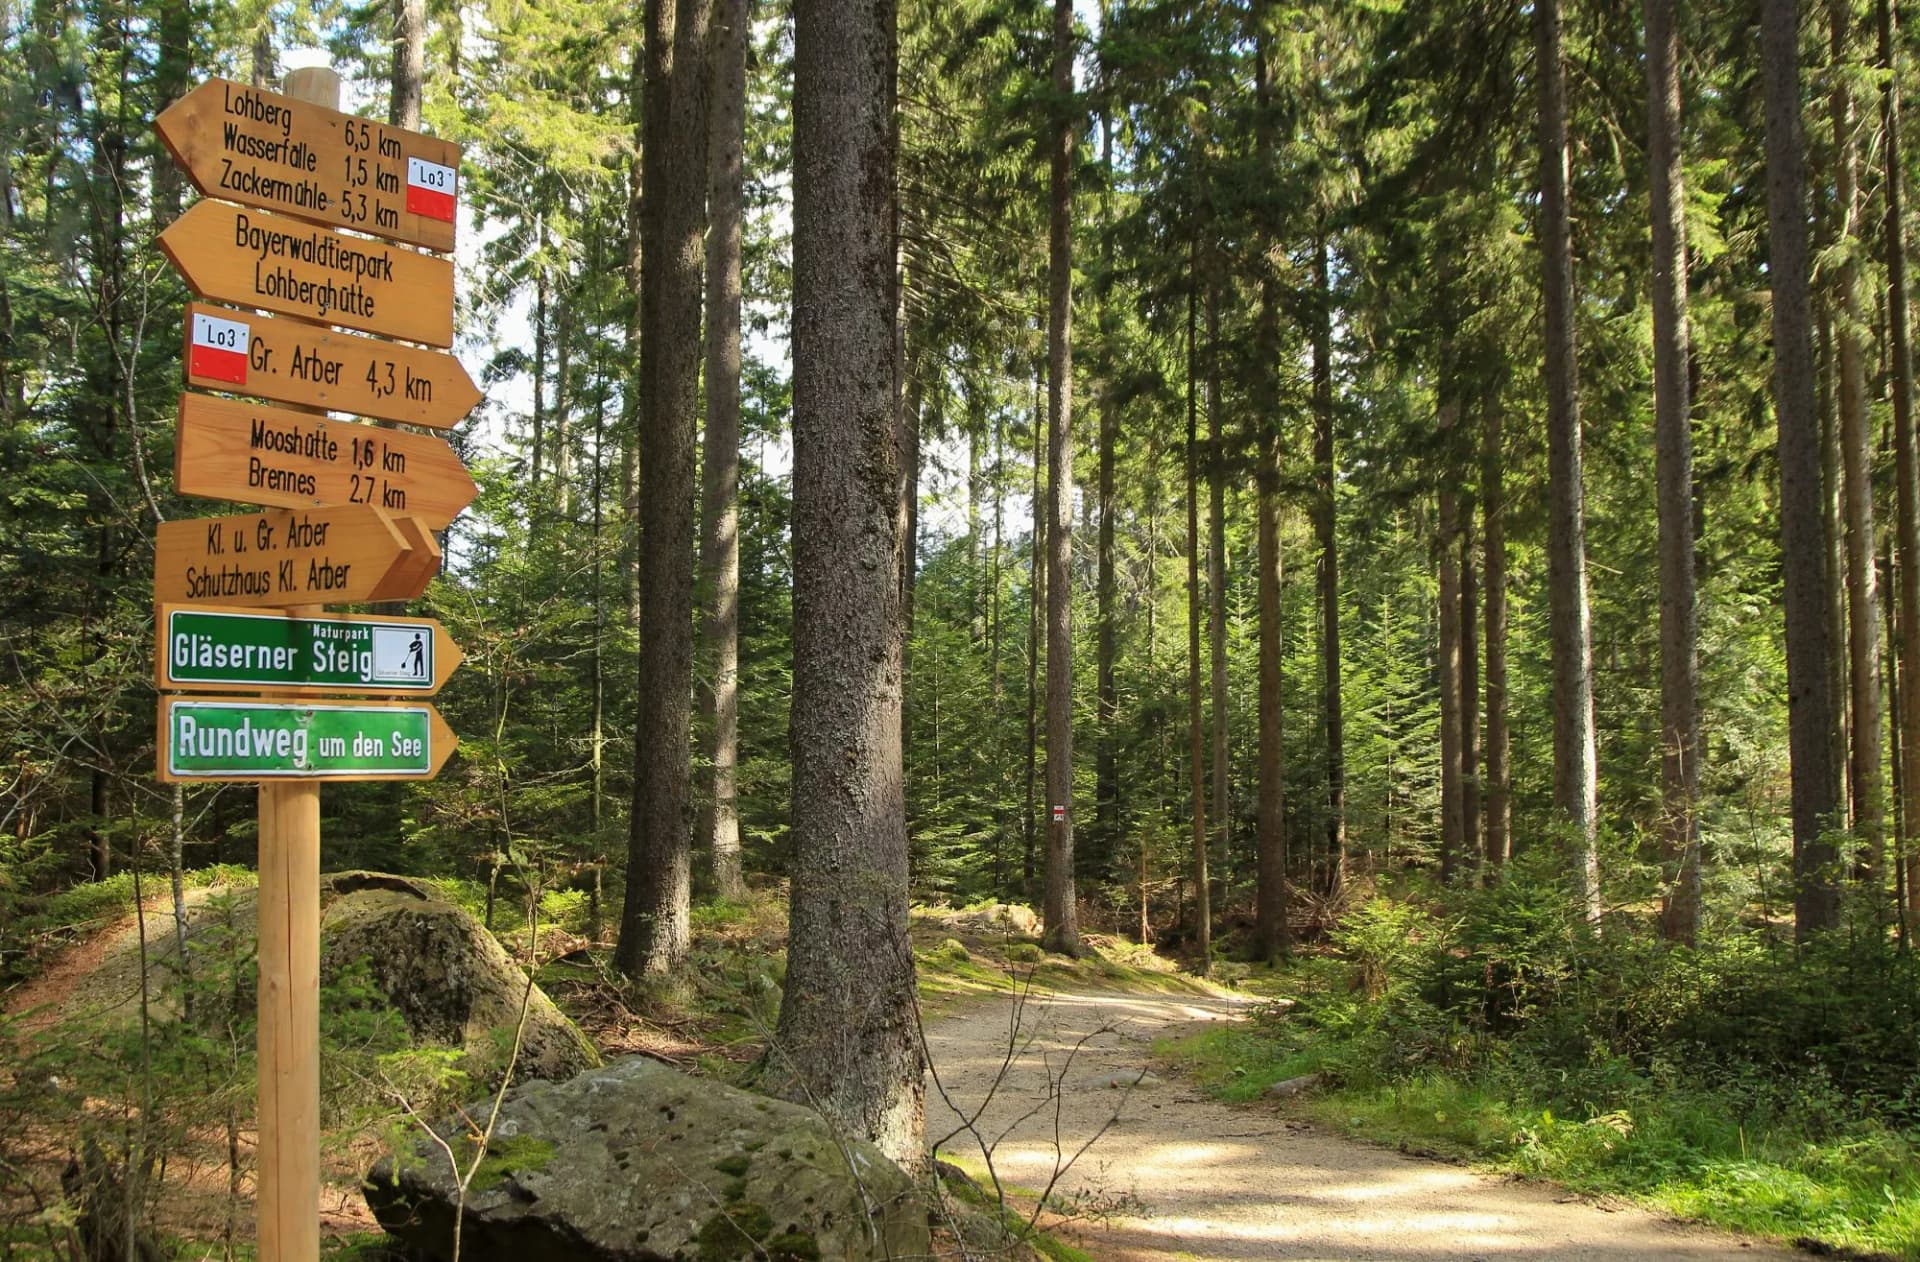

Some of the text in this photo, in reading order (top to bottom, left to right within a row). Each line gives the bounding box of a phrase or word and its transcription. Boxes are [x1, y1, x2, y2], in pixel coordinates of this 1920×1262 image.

[224, 84, 401, 159] Lohberg 6,5 km
[223, 122, 399, 194] Wasserfälle 1,5 km
[419, 166, 444, 187] Lo3
[220, 158, 398, 230] Zackermühle 5,3 km
[236, 214, 393, 283] Bayerwaldtierpark
[255, 262, 375, 318] Lohberghütte
[207, 324, 236, 348] Lo3
[250, 337, 431, 402] Gr. Arber 4,3 km
[251, 418, 405, 475] Mooshütte 1,6 km
[248, 457, 316, 496] Brennes
[382, 480, 406, 510] km
[208, 515, 330, 555] Kl. u. Gr. Arber
[186, 557, 351, 599] Schutzhaus Kl. Arber
[175, 633, 372, 682] Gläserner Steig
[313, 623, 369, 641] Naturpark
[178, 715, 422, 768] Rundweg um den See
